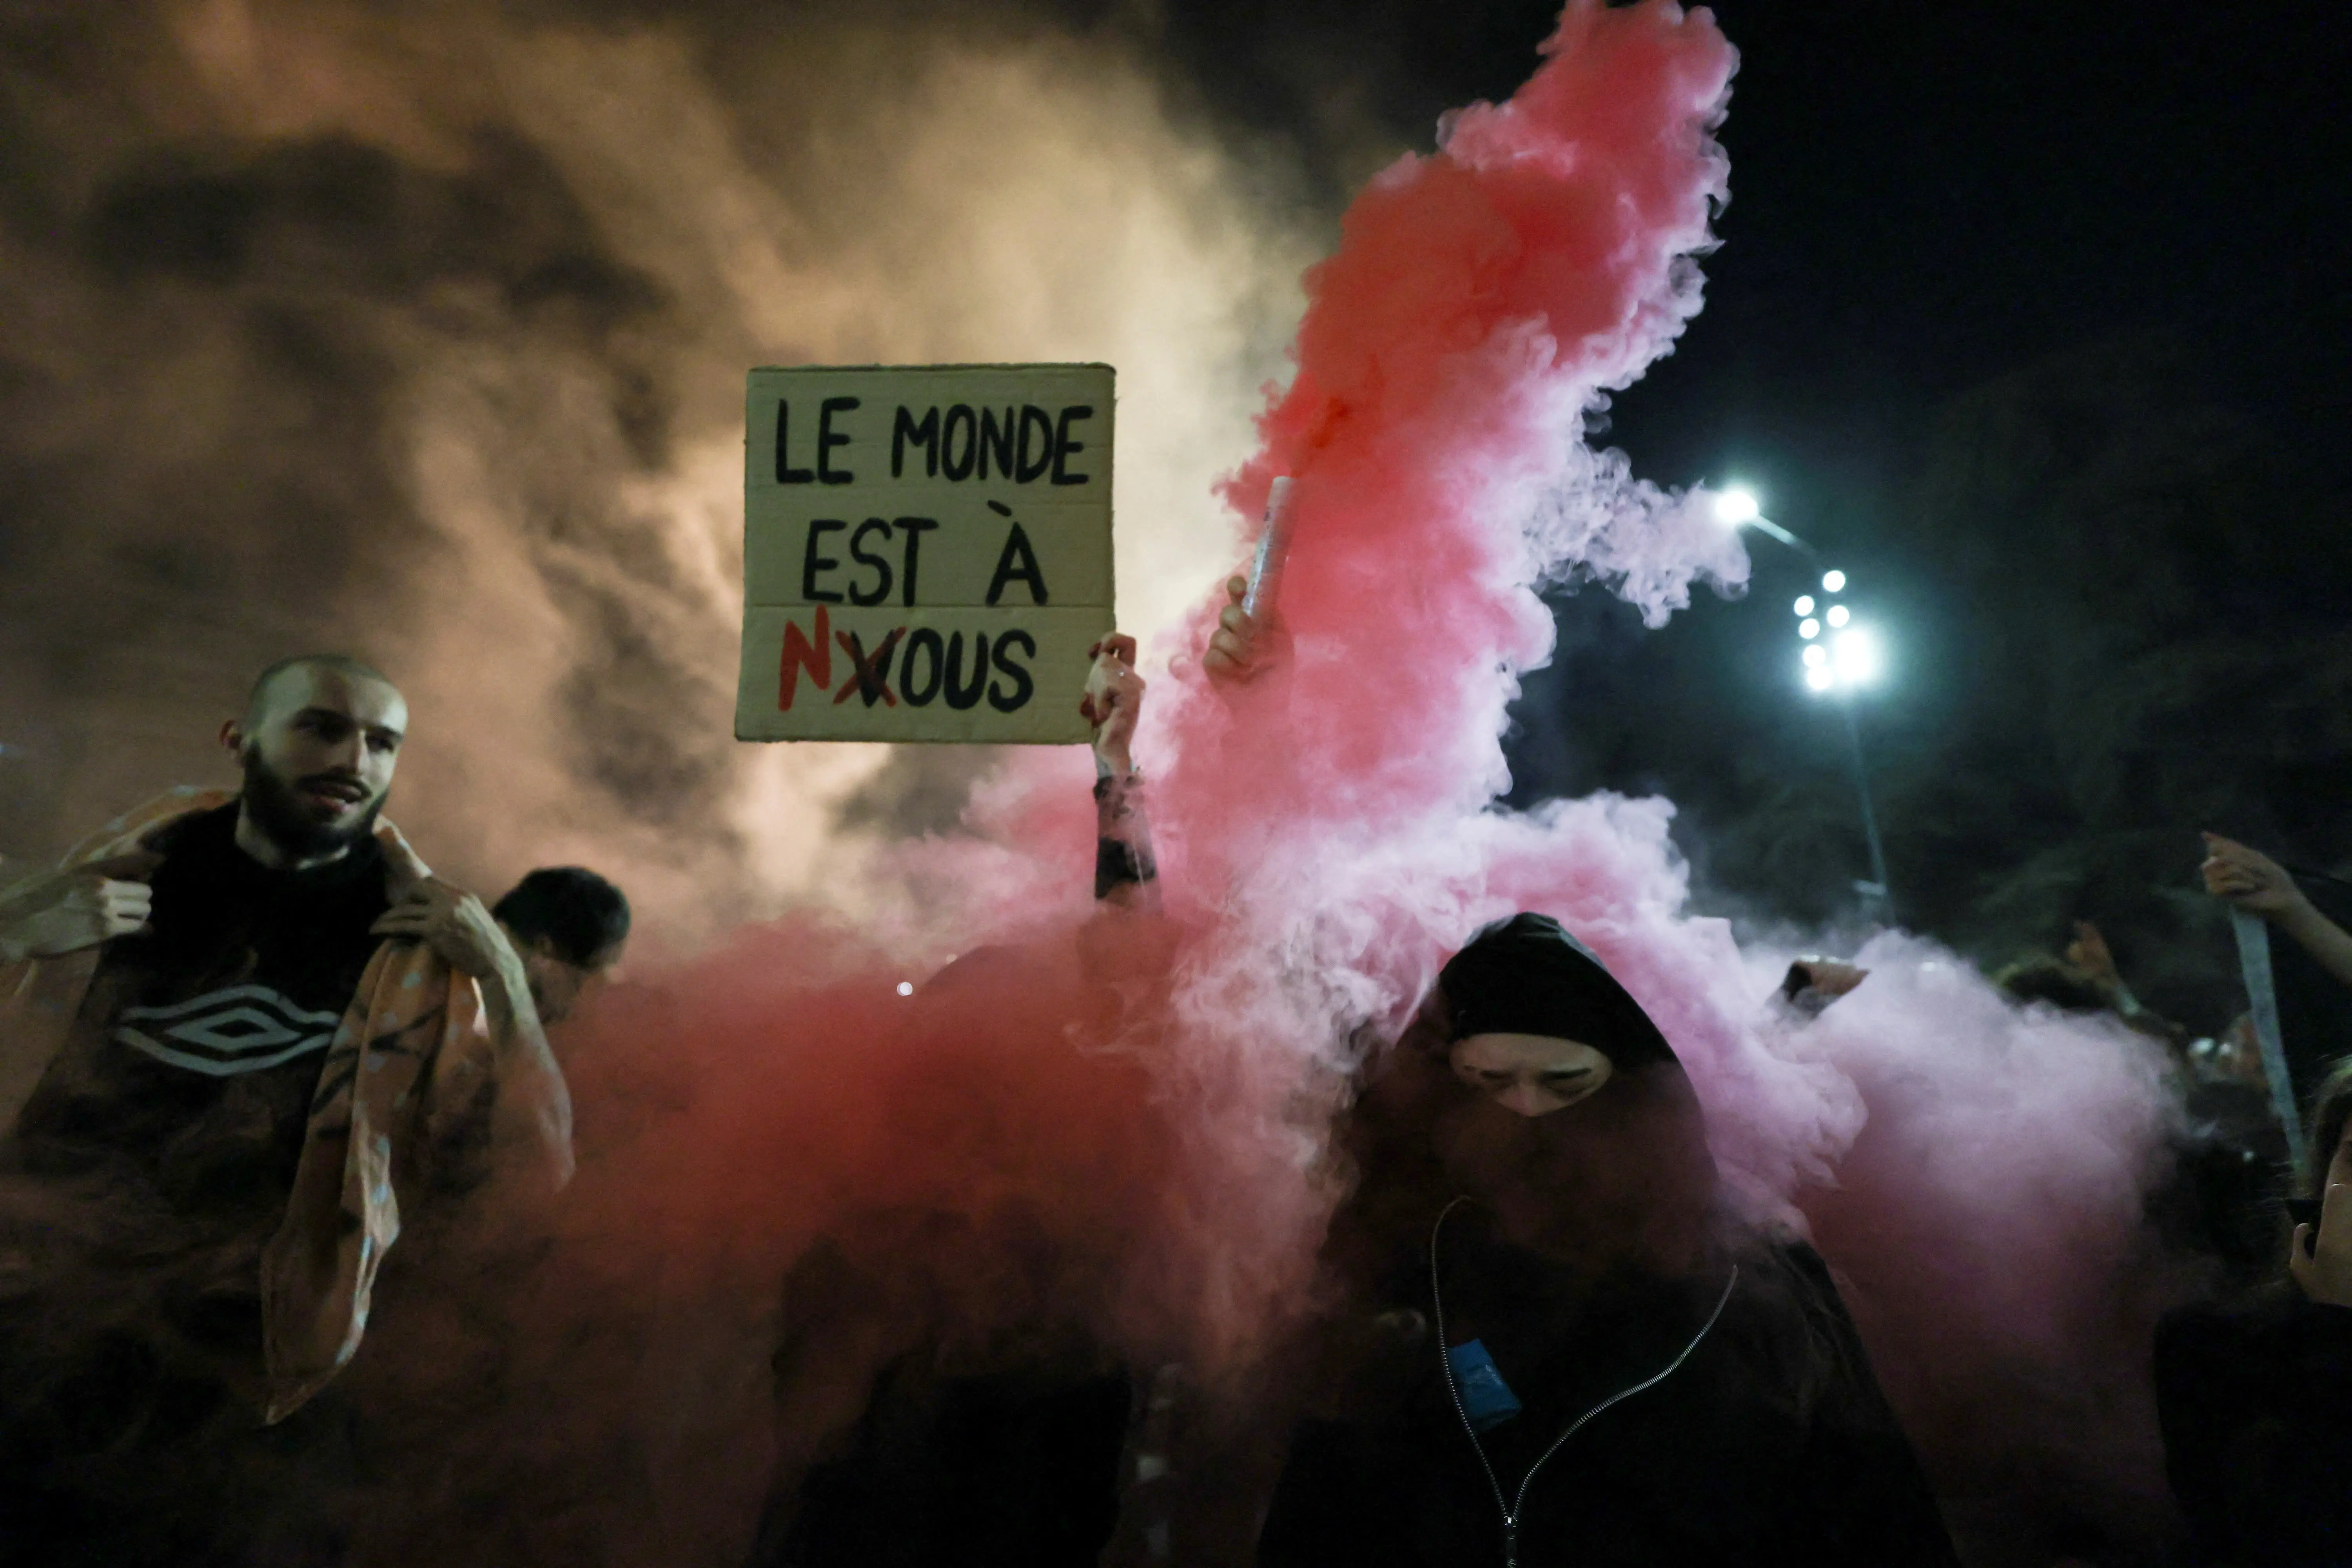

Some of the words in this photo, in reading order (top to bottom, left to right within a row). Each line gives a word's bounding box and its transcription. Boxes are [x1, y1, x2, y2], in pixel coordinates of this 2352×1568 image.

[775, 396, 861, 485] LE
[891, 403, 1093, 485] MONDE
[802, 517, 939, 607] EST
[985, 499, 1049, 606] À
